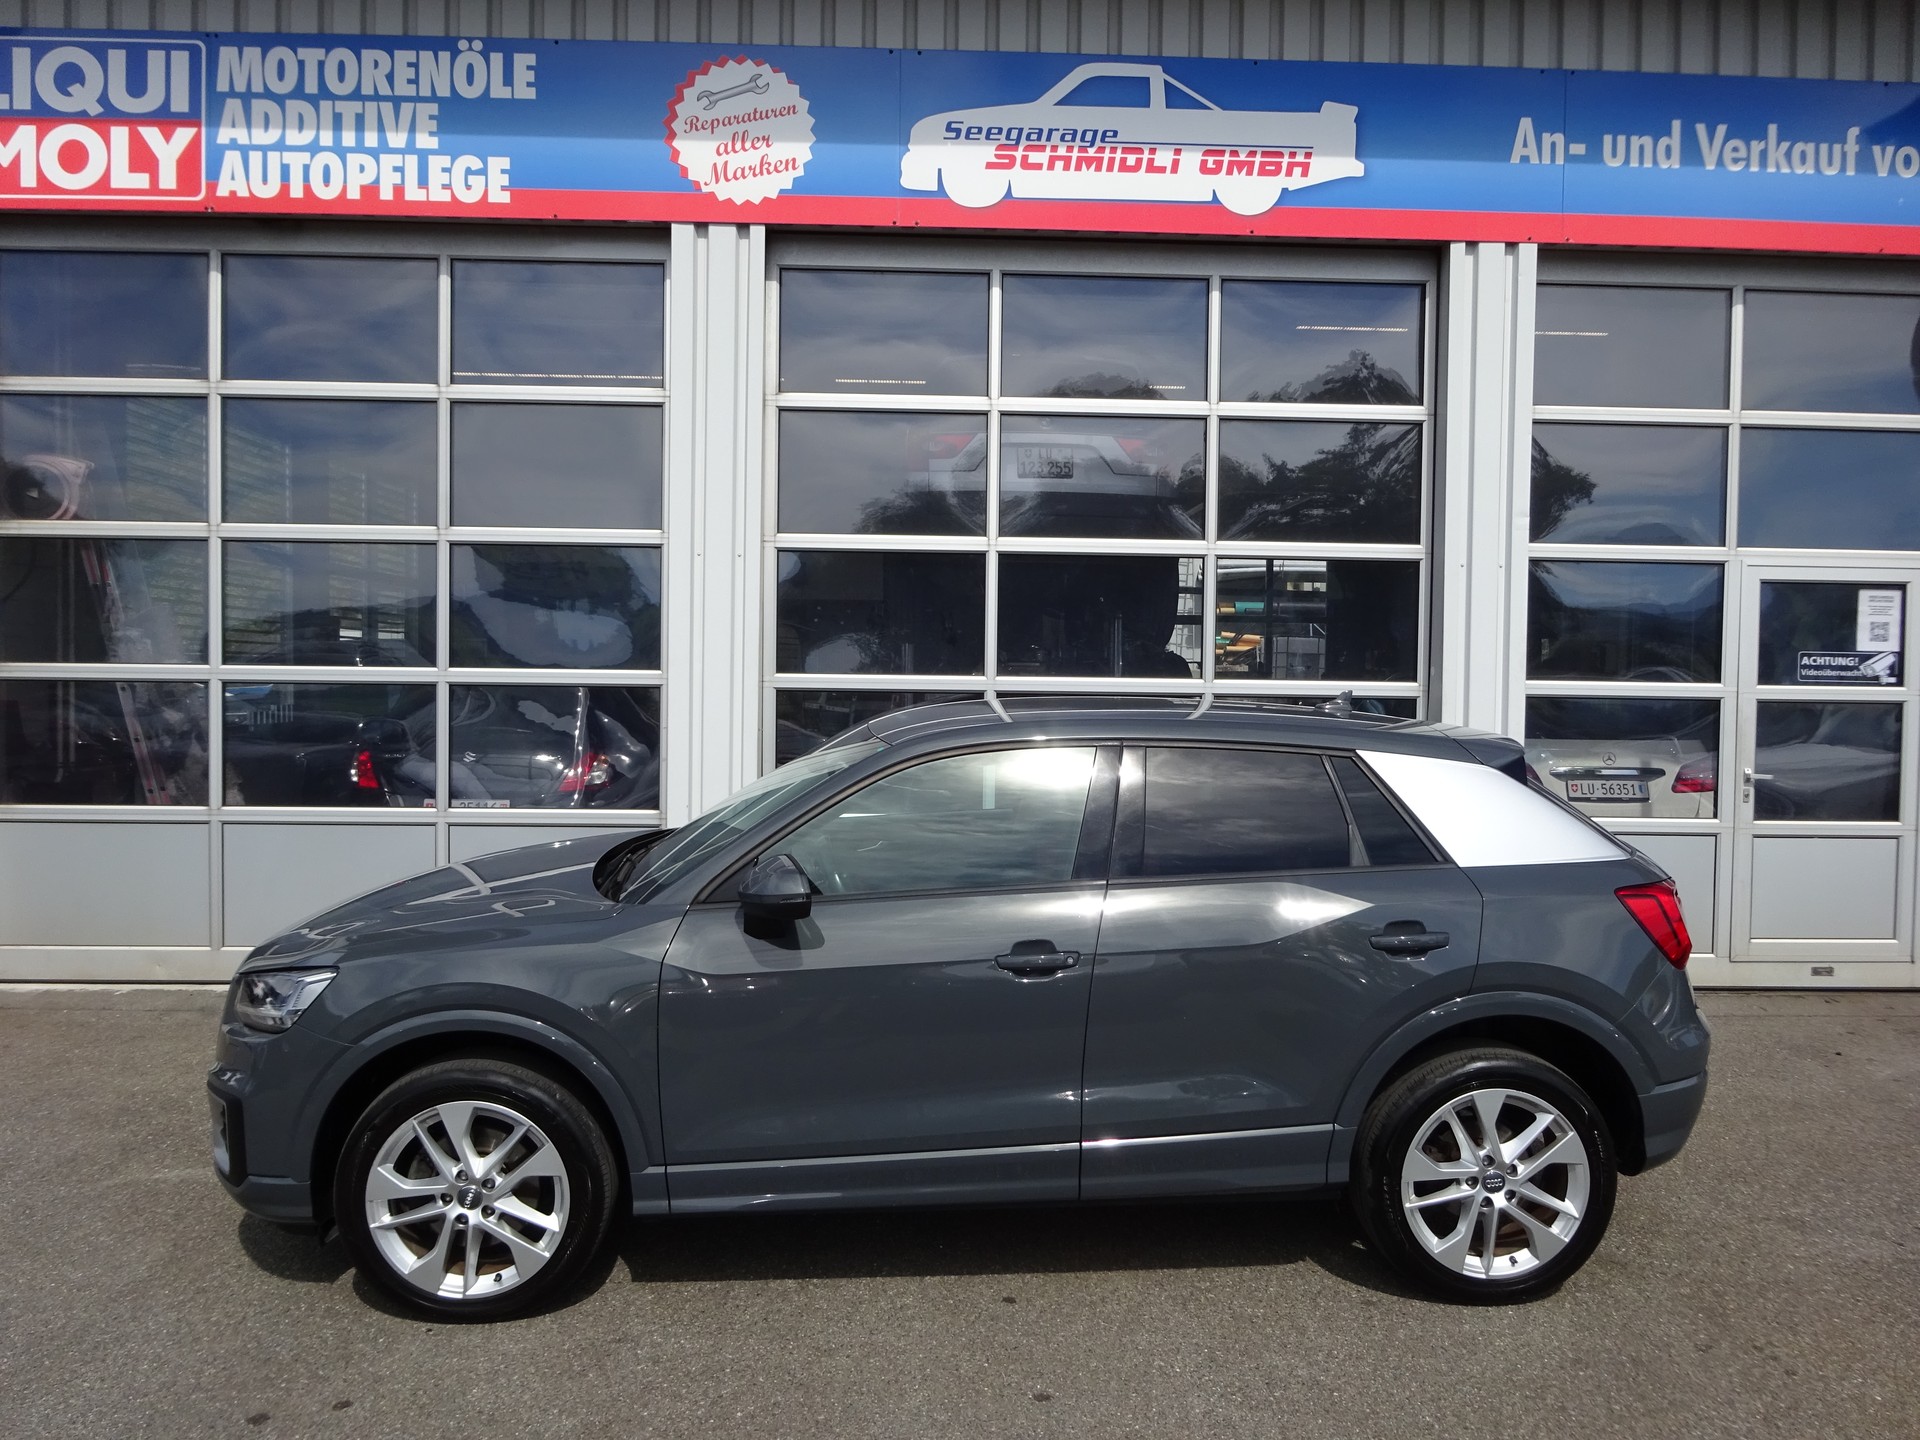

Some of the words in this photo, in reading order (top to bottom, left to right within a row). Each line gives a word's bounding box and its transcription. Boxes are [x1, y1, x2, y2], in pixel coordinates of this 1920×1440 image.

[0, 46, 190, 116] IQUI
[216, 39, 537, 100] MOTORENÖLE
[216, 99, 439, 149] ADDITIVE
[683, 104, 799, 135] Reparaturen
[943, 120, 1118, 147] Seegarage
[715, 130, 773, 157] aller
[1510, 117, 1586, 165] An-
[1603, 119, 1681, 169] und
[1695, 123, 1861, 176] Verkauf
[216, 150, 511, 203] AUTOPFLEGE
[703, 153, 800, 186] Marken
[985, 144, 1182, 175] SCHMIDLI
[1198, 148, 1313, 178] GMBH
[1801, 656, 1859, 666] ACHTUNG!
